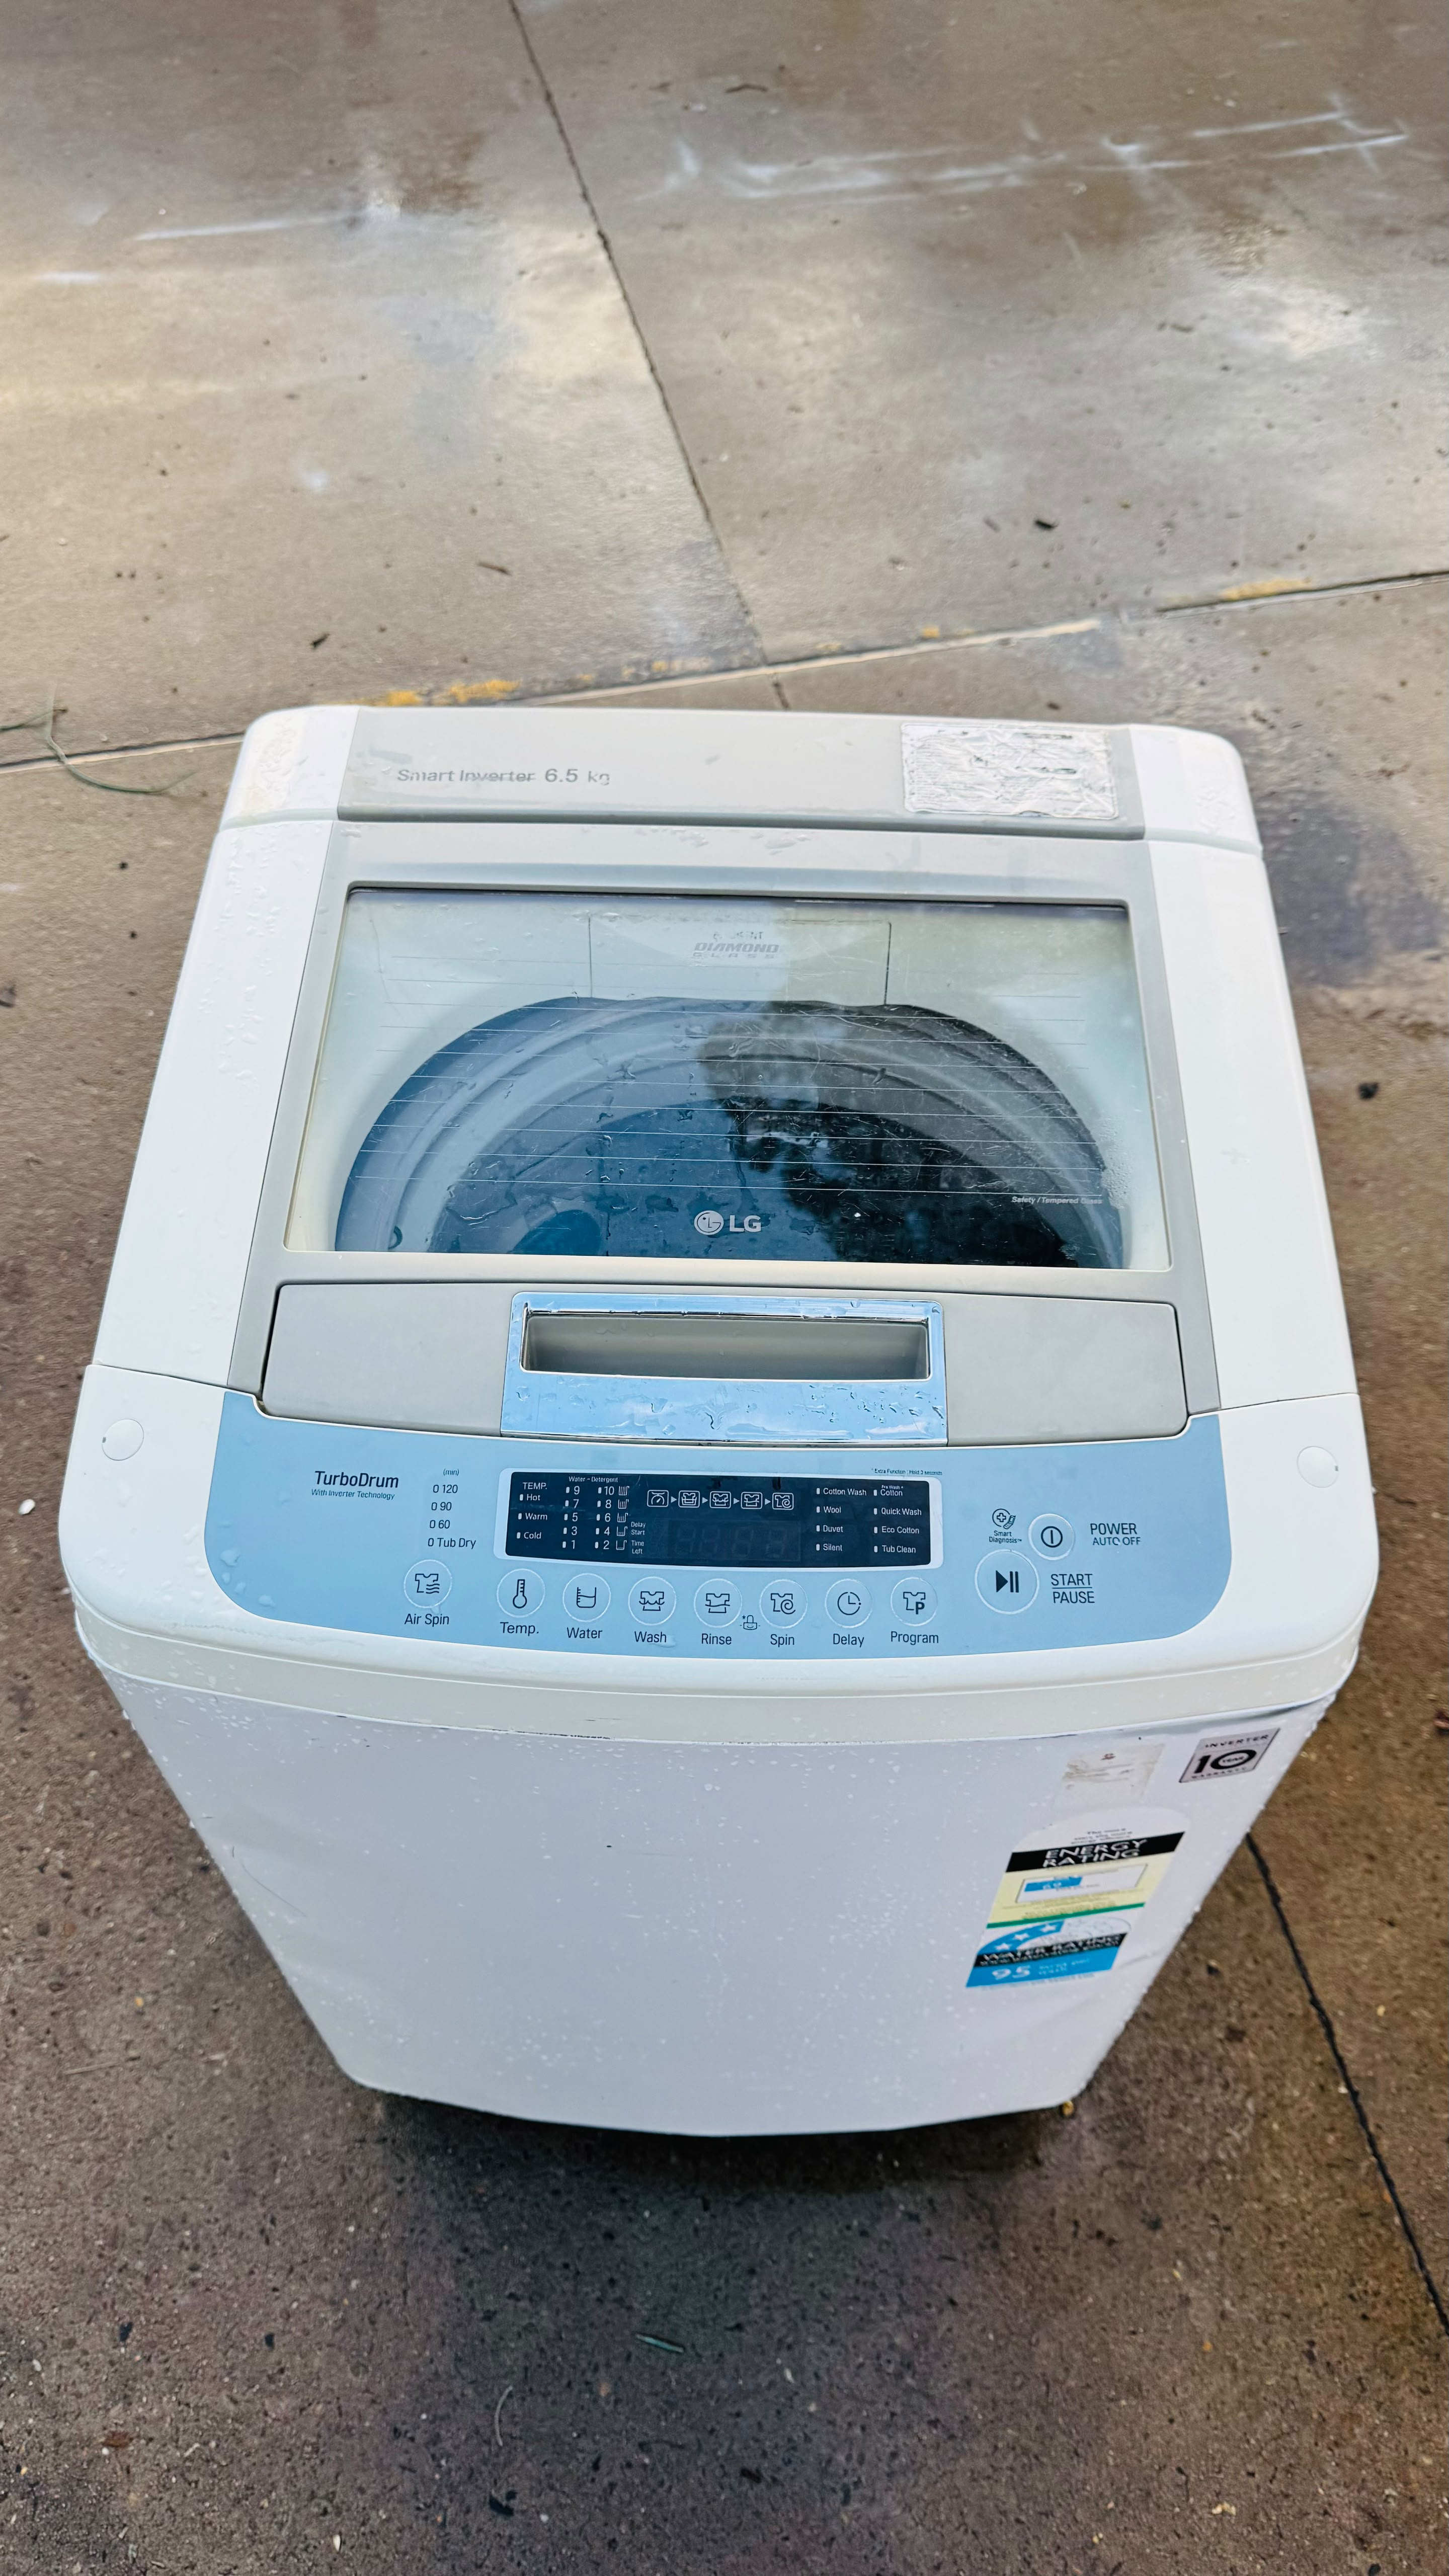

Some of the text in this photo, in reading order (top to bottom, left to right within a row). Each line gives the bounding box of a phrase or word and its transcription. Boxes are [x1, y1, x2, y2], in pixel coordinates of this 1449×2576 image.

[397, 768, 610, 786] Smart Inverter 6.5 kg
[694, 942, 779, 953] DIAMOND
[1012, 1196, 1036, 1204] Safety
[730, 1215, 761, 1233] LG
[443, 1468, 459, 1476] (min)
[314, 1470, 399, 1488] TurboDrum
[311, 1488, 395, 1500] With Inverter Technology
[442, 1484, 458, 1494] 120
[574, 1485, 580, 1495] 9
[604, 1486, 615, 1495] 10
[823, 1488, 867, 1496] Cotton Wash
[526, 1493, 540, 1501] Hot
[439, 1501, 452, 1511] 90
[573, 1499, 580, 1508] 7
[605, 1499, 612, 1509] 8
[823, 1506, 841, 1514] Wool
[881, 1508, 922, 1516] Quick Wash
[525, 1512, 548, 1521] Warm
[572, 1512, 578, 1522] 5
[604, 1513, 611, 1522] 6
[438, 1519, 450, 1529] 60
[823, 1525, 843, 1533] Duvet
[1090, 1523, 1138, 1535] POWER
[524, 1532, 541, 1540] Cold
[571, 1526, 578, 1536] 3
[603, 1526, 610, 1536] 4
[437, 1537, 476, 1550] Tub Dry
[571, 1540, 576, 1550] 1
[603, 1541, 610, 1550] 2
[1092, 1537, 1141, 1546] AUTO OFF
[823, 1544, 843, 1552] Silent
[881, 1545, 916, 1554] Tub Clean
[1051, 1573, 1093, 1586] START
[1053, 1591, 1095, 1603] PAUSE
[404, 1613, 450, 1628] Air Spin
[500, 1621, 539, 1637] Temp.
[567, 1627, 603, 1639] Water
[634, 1631, 667, 1643] Wash
[701, 1633, 732, 1645] Rinse
[770, 1634, 795, 1648] Spin
[833, 1633, 865, 1648] Delay
[891, 1631, 939, 1645] Program
[1205, 1734, 1268, 1748] INVERTER
[1194, 1749, 1257, 1774] 10
[1045, 1839, 1148, 1859] ENERGY
[1042, 1848, 1141, 1868] RATING
[992, 1964, 1031, 1980] 95
